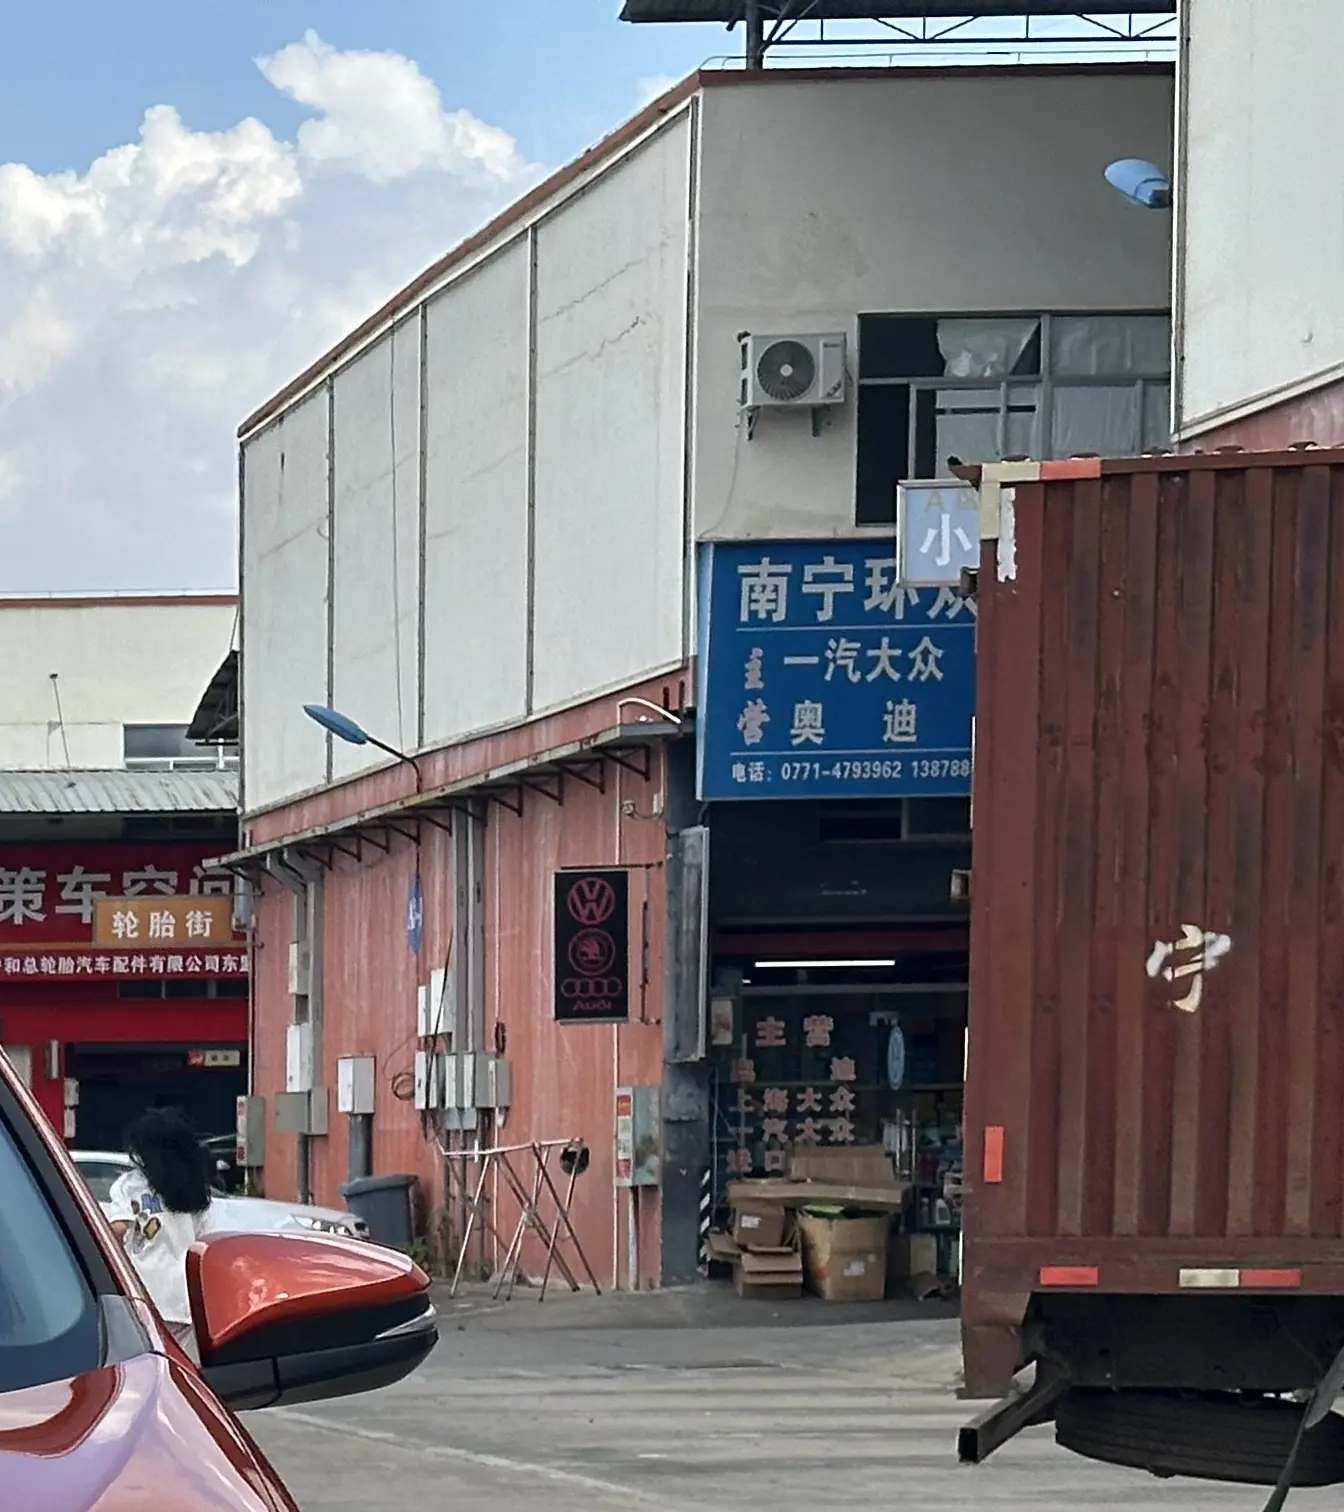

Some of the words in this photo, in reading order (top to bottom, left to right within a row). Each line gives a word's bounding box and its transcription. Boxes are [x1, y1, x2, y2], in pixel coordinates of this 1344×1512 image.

[919, 513, 972, 566] 小
[784, 636, 944, 684] 一汽大众
[780, 761, 902, 781] 0771-4793962
[112, 910, 214, 939] 轮胎街
